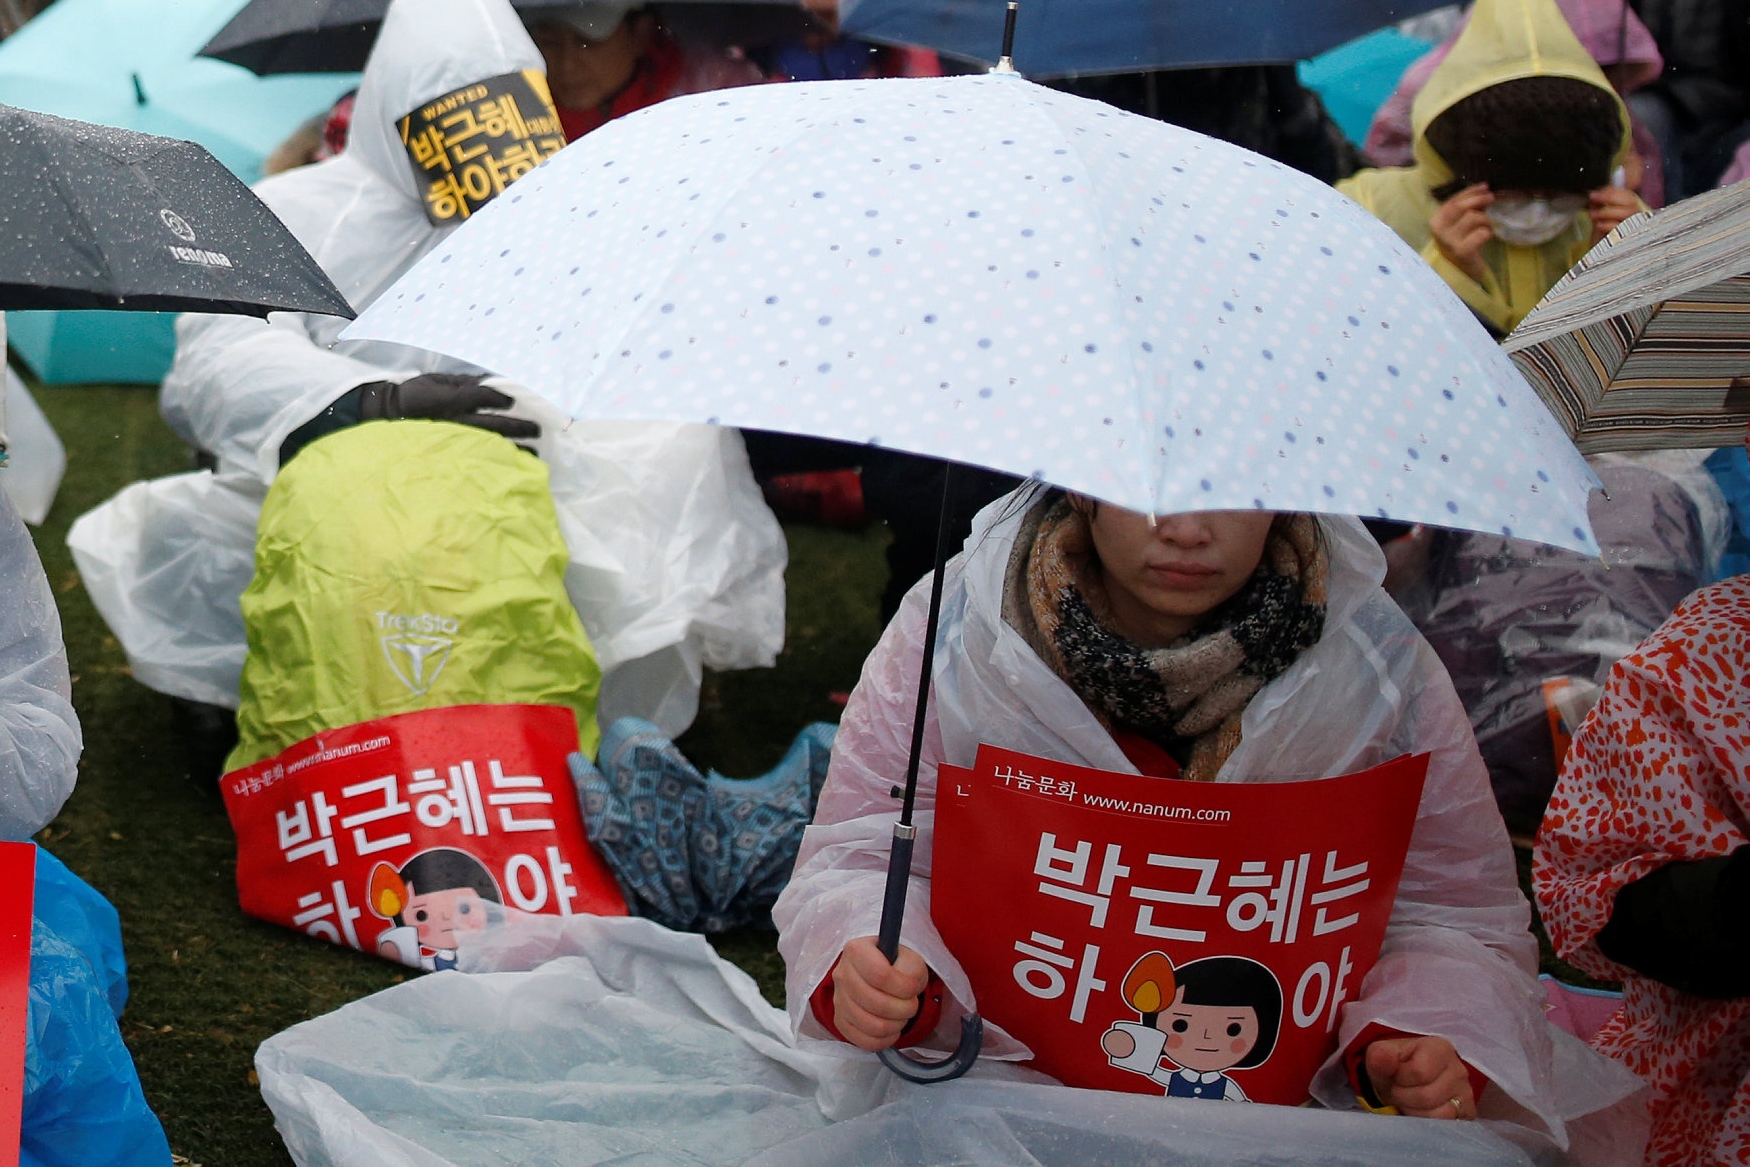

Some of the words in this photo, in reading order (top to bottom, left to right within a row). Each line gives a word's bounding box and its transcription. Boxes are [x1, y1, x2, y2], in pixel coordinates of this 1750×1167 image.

[409, 92, 530, 173] 박근혜
[421, 84, 490, 121] WANTED
[168, 244, 234, 269] renoma
[275, 759, 557, 868] 박근혜는
[993, 763, 1079, 802] 나눔문화
[1083, 792, 1232, 823] www.nanum.com
[292, 880, 362, 949] 하
[504, 845, 578, 917] 야
[1032, 830, 1371, 945] 박근혜는
[1012, 930, 1107, 1024] 하
[1291, 945, 1355, 1034] 야
